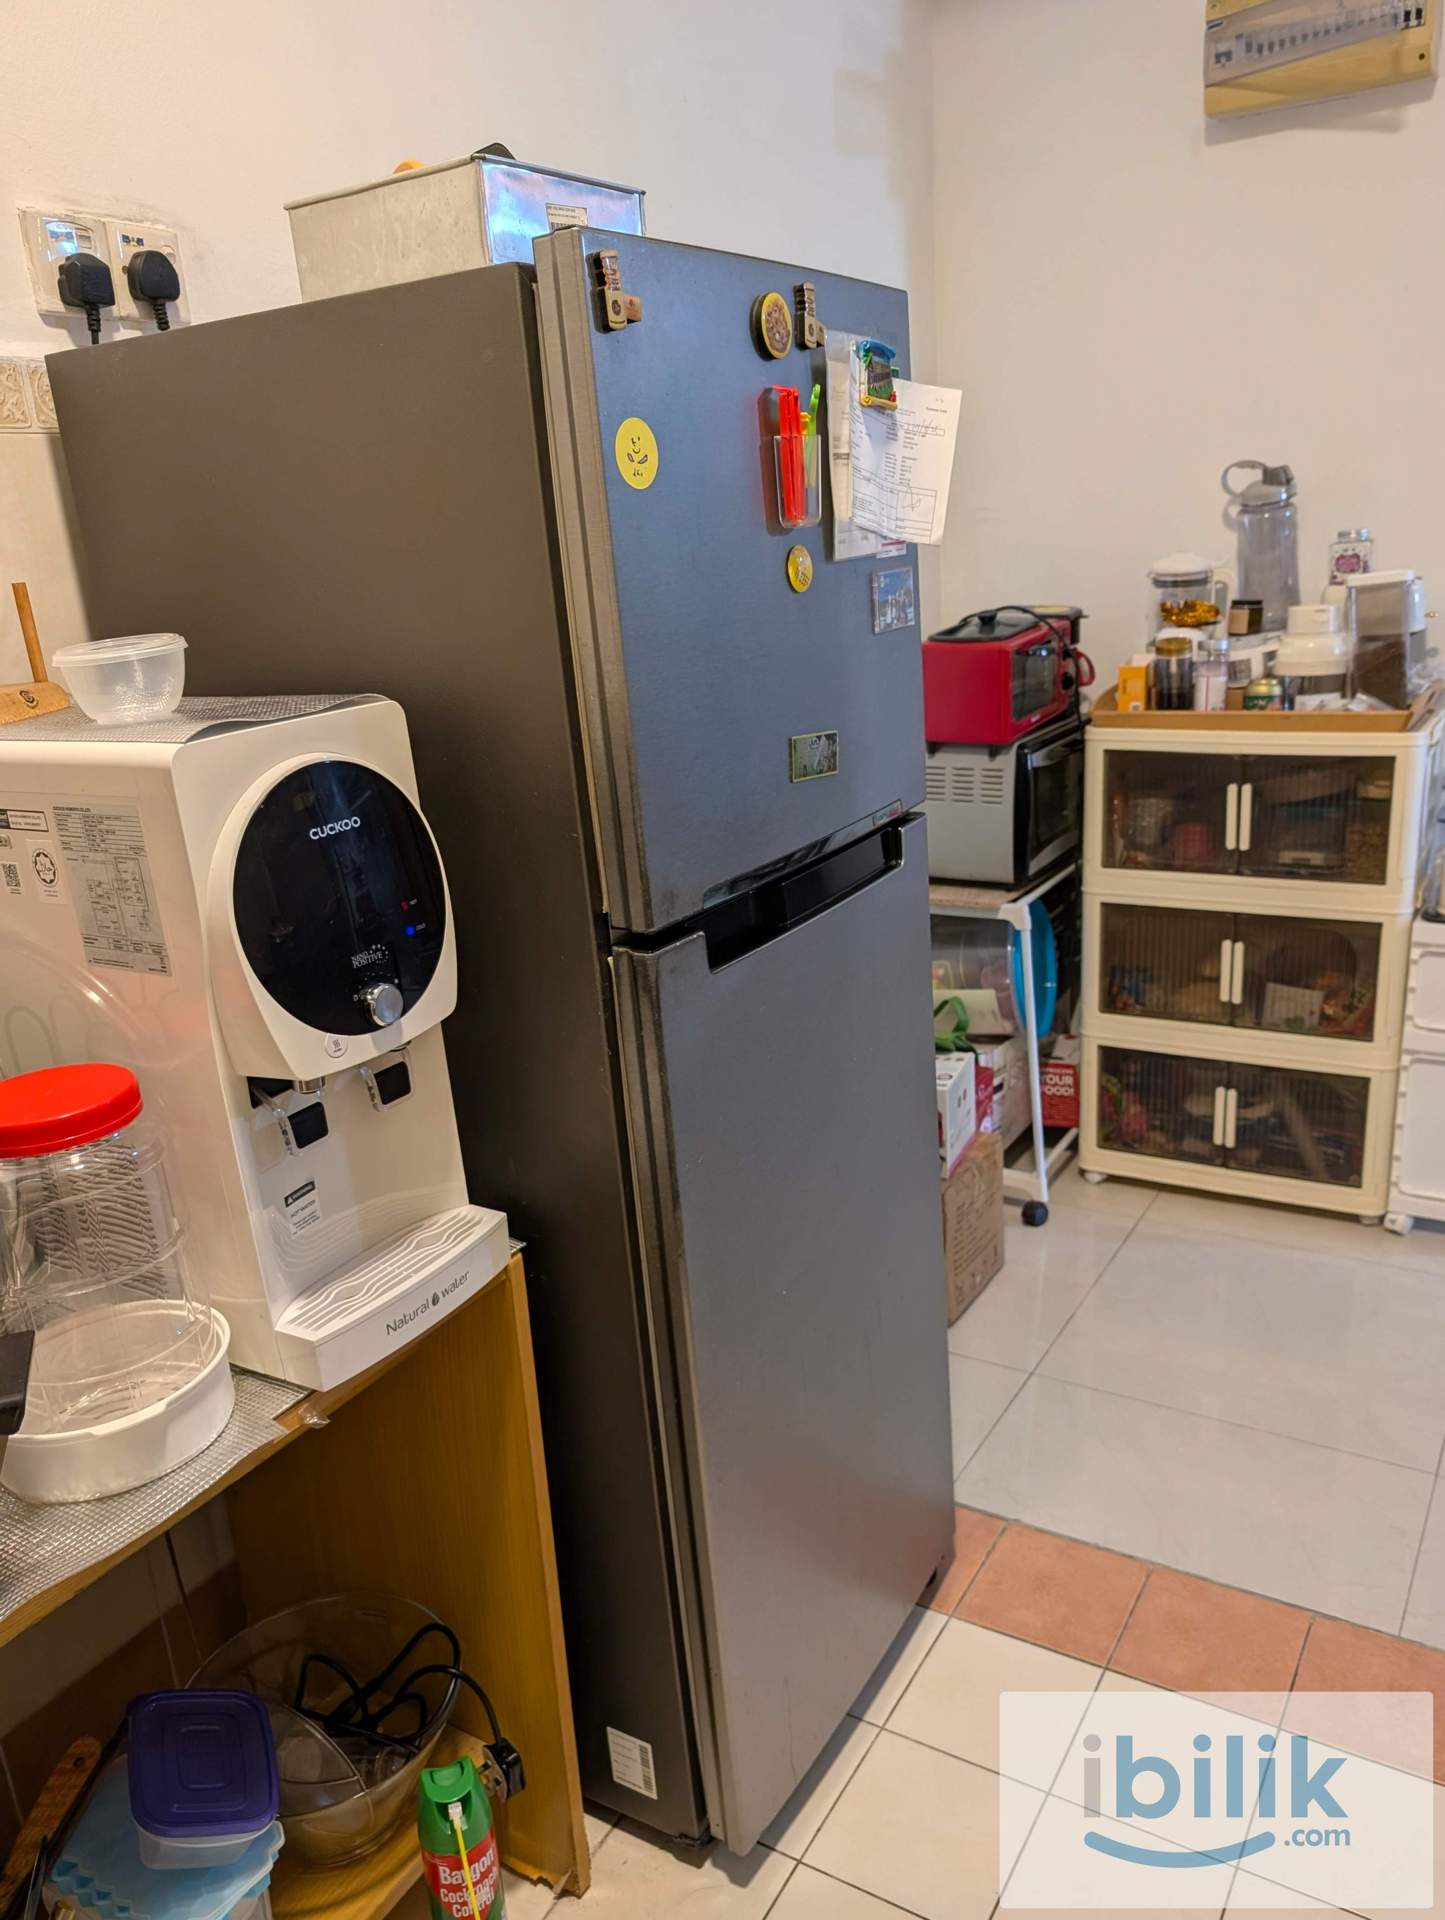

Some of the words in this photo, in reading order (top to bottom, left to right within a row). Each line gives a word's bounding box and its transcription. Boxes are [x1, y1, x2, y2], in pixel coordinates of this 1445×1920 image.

[309, 816, 361, 840] CUCKOO
[1041, 1086, 1074, 1097] OOD!
[385, 1298, 430, 1335] Natural
[440, 1271, 470, 1298] water
[438, 1848, 494, 1887] Baygon
